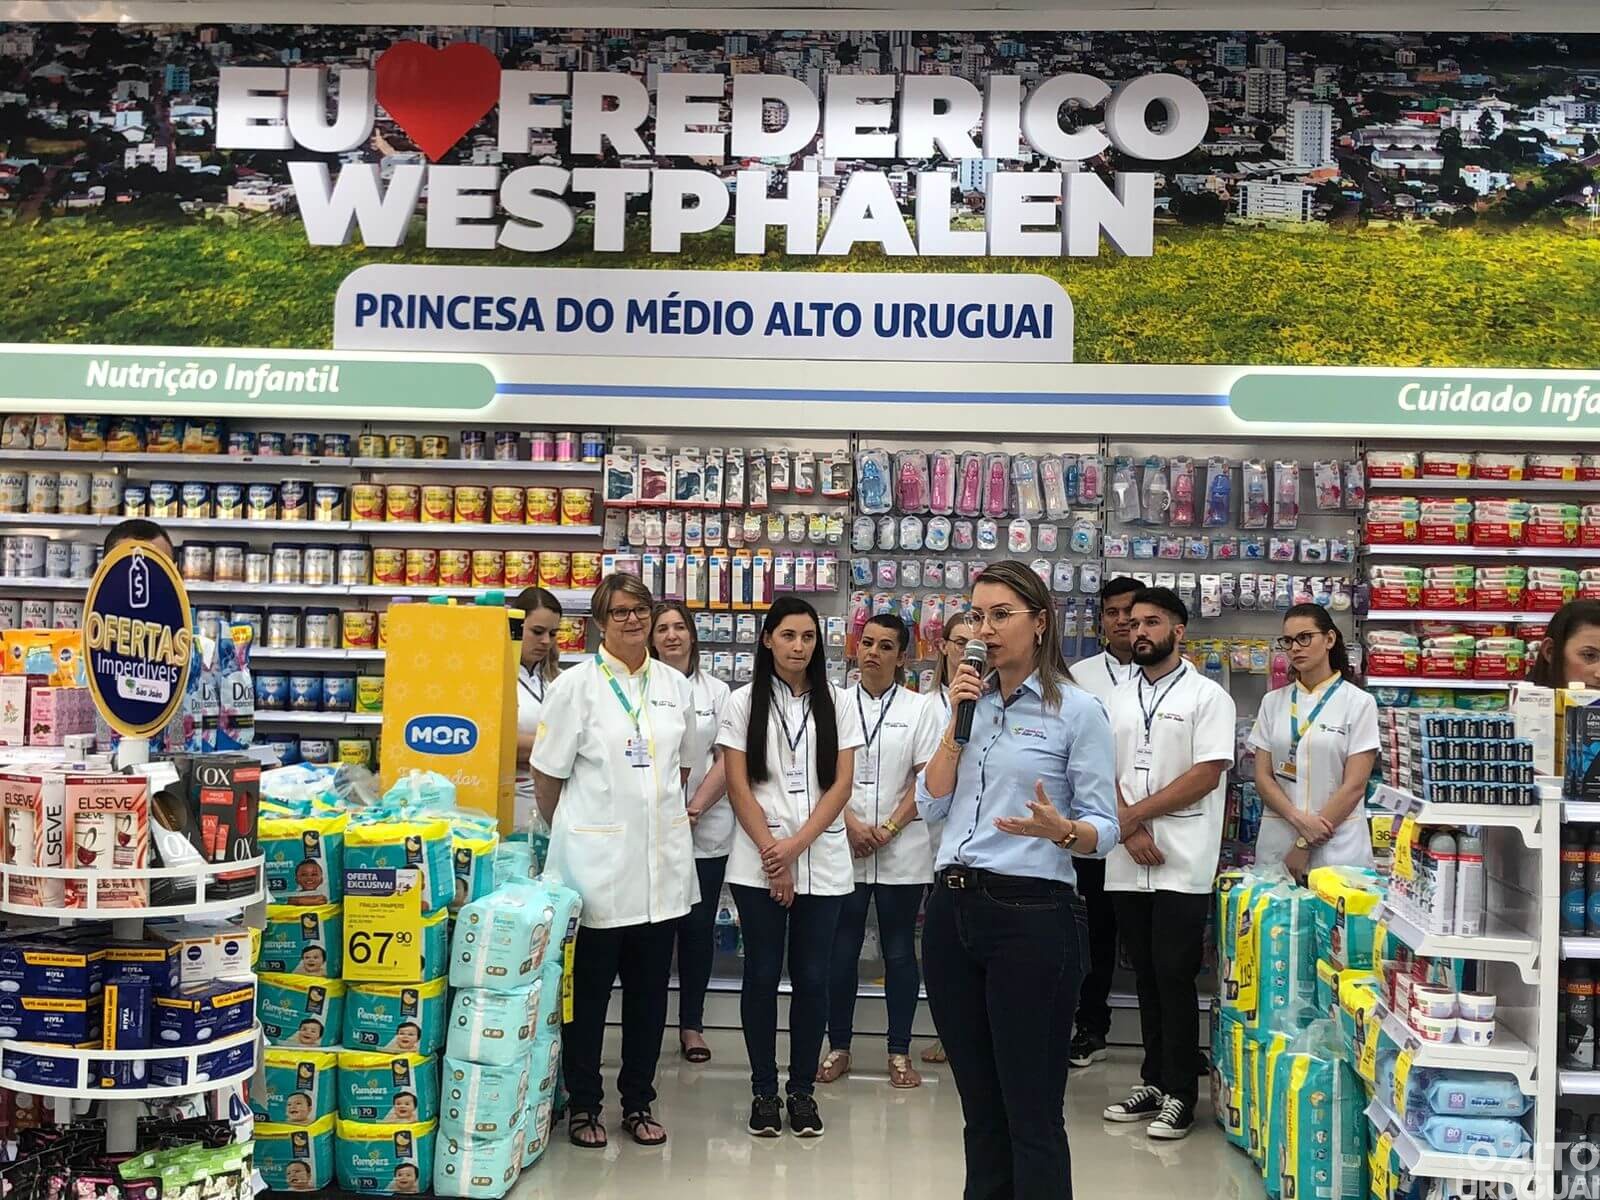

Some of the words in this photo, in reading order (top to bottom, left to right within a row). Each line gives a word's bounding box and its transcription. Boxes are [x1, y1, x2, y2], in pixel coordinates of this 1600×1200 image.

[215, 66, 376, 153] EU
[500, 69, 1210, 161] FREDERICO
[287, 161, 1155, 257] WESTPHALEN
[355, 292, 546, 333] PRINCESA
[555, 298, 615, 334] DO
[626, 291, 754, 336] MÉDIO
[764, 301, 863, 338] ALTO
[873, 303, 1053, 340] URUGUAI
[86, 359, 218, 396] Nutrição
[224, 362, 340, 398] Infantil
[1398, 382, 1532, 414] Cuidado
[86, 611, 190, 667] OFERTAS
[411, 725, 471, 746] MOR
[203, 767, 231, 786] OX
[4, 792, 34, 807] ELSEVE
[78, 796, 134, 810] ELSEVE
[46, 804, 63, 868] LSEVE
[1375, 830, 1392, 841] 36
[271, 879, 283, 888] 52
[346, 872, 378, 881] OFERTA
[347, 881, 393, 890] EXCLUSIVA!
[395, 931, 412, 944] 90
[270, 961, 281, 969] 70
[357, 1007, 394, 1023] Pampers
[266, 1025, 277, 1034] 70
[363, 1033, 375, 1041] 70
[351, 1083, 388, 1097] Pampers
[1450, 1093, 1464, 1102] 80
[362, 1107, 373, 1115] 70
[1446, 1127, 1460, 1138] 80
[352, 1154, 390, 1167] Pampers
